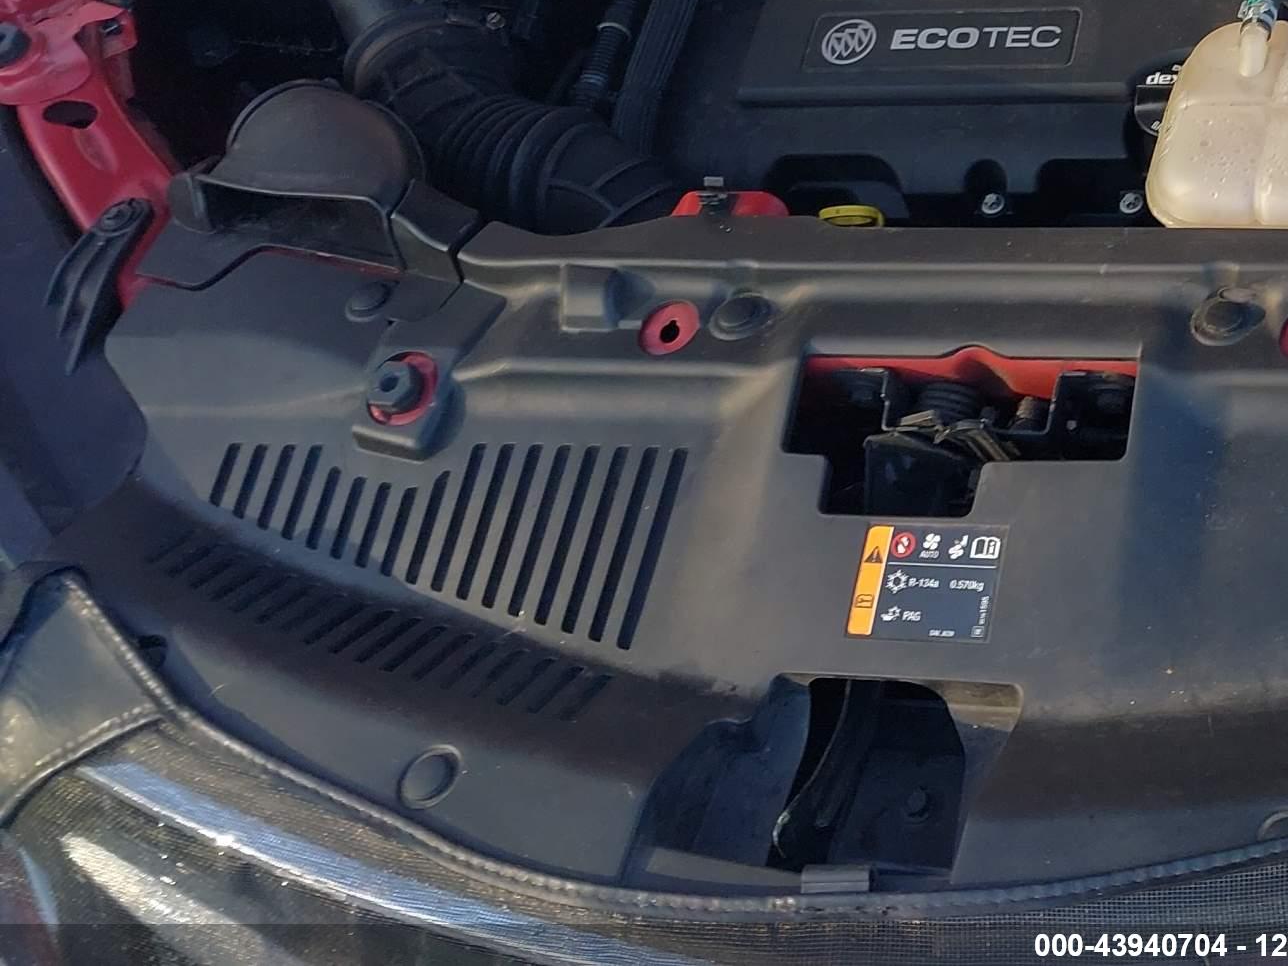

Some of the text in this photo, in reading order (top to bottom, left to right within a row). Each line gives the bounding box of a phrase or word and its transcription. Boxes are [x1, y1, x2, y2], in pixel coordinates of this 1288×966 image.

[890, 25, 1062, 51] ECOTEC
[919, 550, 940, 559] AUTO
[908, 578, 985, 592] R-134a 0.570kg
[902, 610, 922, 621] PAG
